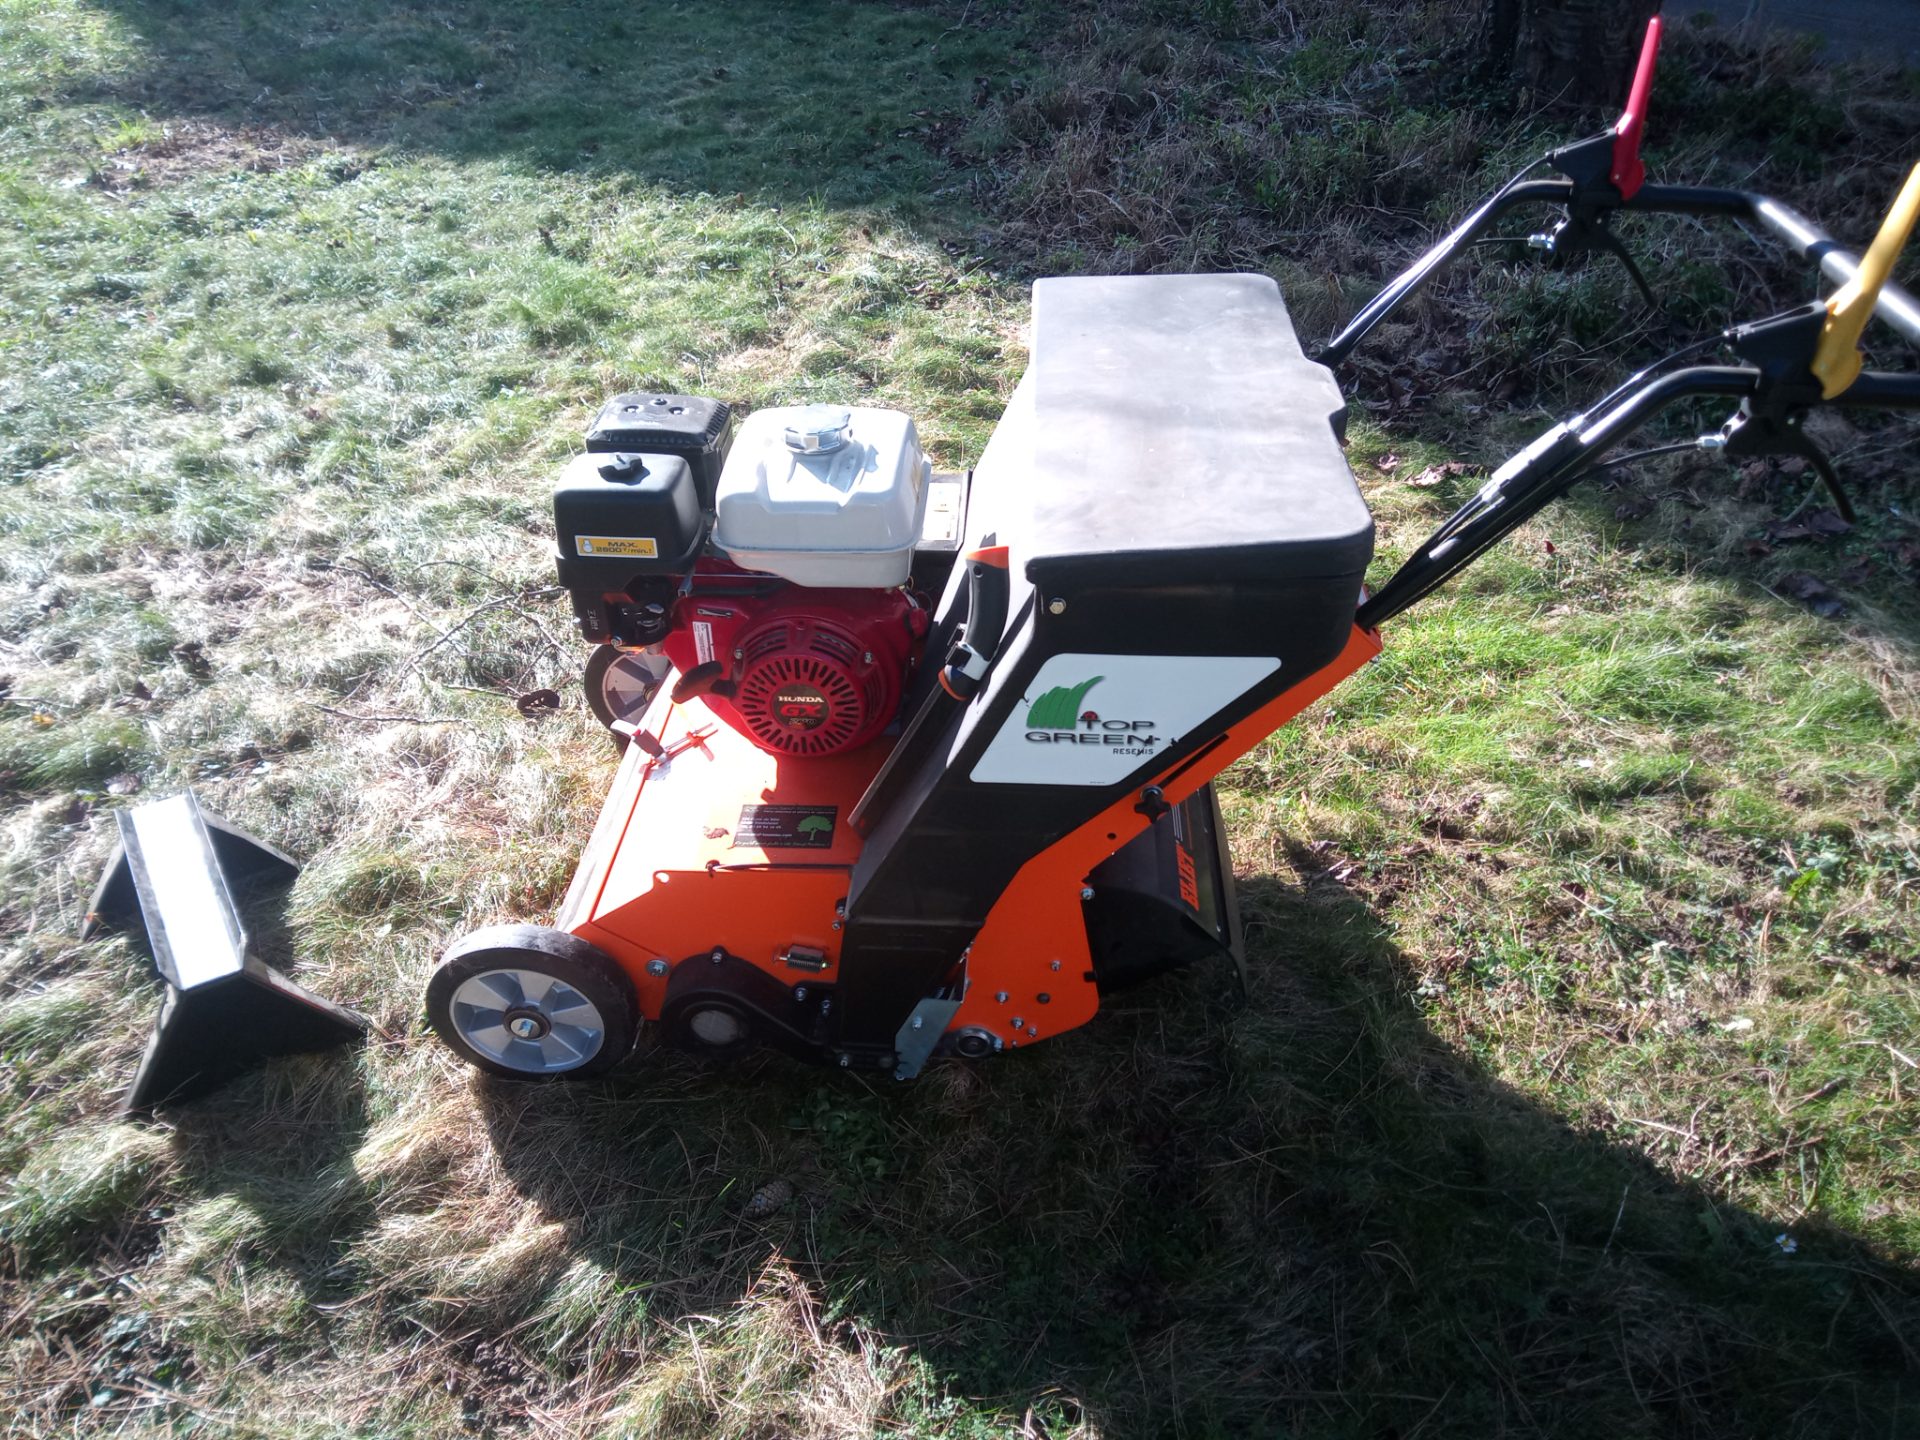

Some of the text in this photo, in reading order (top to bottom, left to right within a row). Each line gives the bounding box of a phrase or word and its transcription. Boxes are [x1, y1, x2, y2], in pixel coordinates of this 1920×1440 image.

[778, 695, 825, 703] HONDA
[780, 704, 822, 717] GX
[1077, 719, 1155, 731] TOP
[1025, 731, 1155, 746] GREEN
